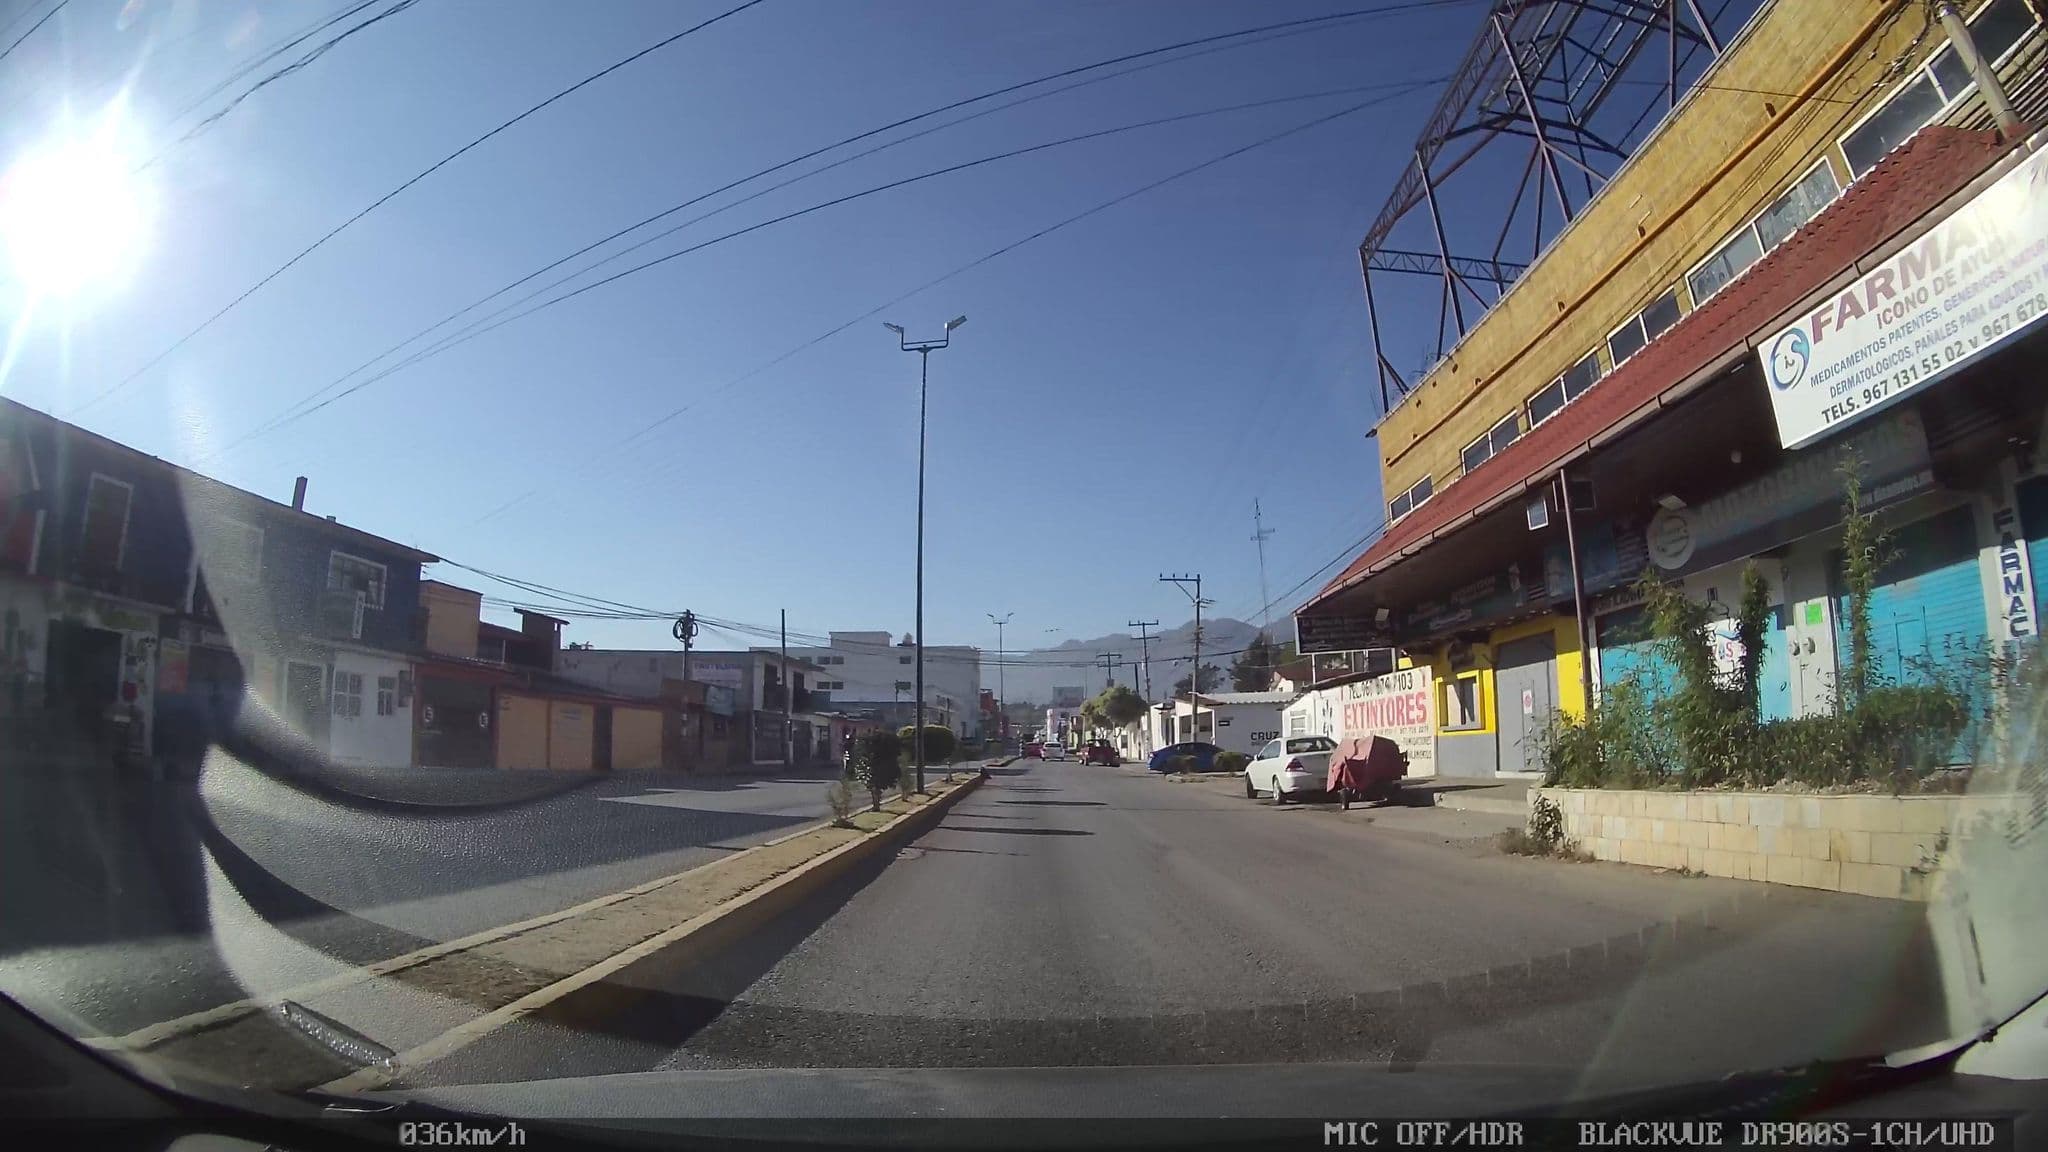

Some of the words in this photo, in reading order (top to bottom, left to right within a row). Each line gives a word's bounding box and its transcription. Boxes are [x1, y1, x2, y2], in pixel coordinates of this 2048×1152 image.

[1877, 286, 1929, 329] ICONO
[1933, 267, 1957, 296] DE
[1915, 320, 1958, 353] PAÑALES
[1960, 304, 1986, 329] PARA
[1810, 337, 1887, 387] MEDICAMENTOS
[1889, 307, 1942, 344] PATENTES,
[1821, 397, 1860, 423] TELS.
[1863, 379, 1888, 404] 967
[1893, 364, 1918, 388] 131
[1922, 353, 1941, 375] 55
[1944, 340, 1965, 362] 02
[1982, 313, 2010, 342] 967
[2016, 293, 2048, 322] 678
[1344, 692, 1427, 730] EXTINTORES
